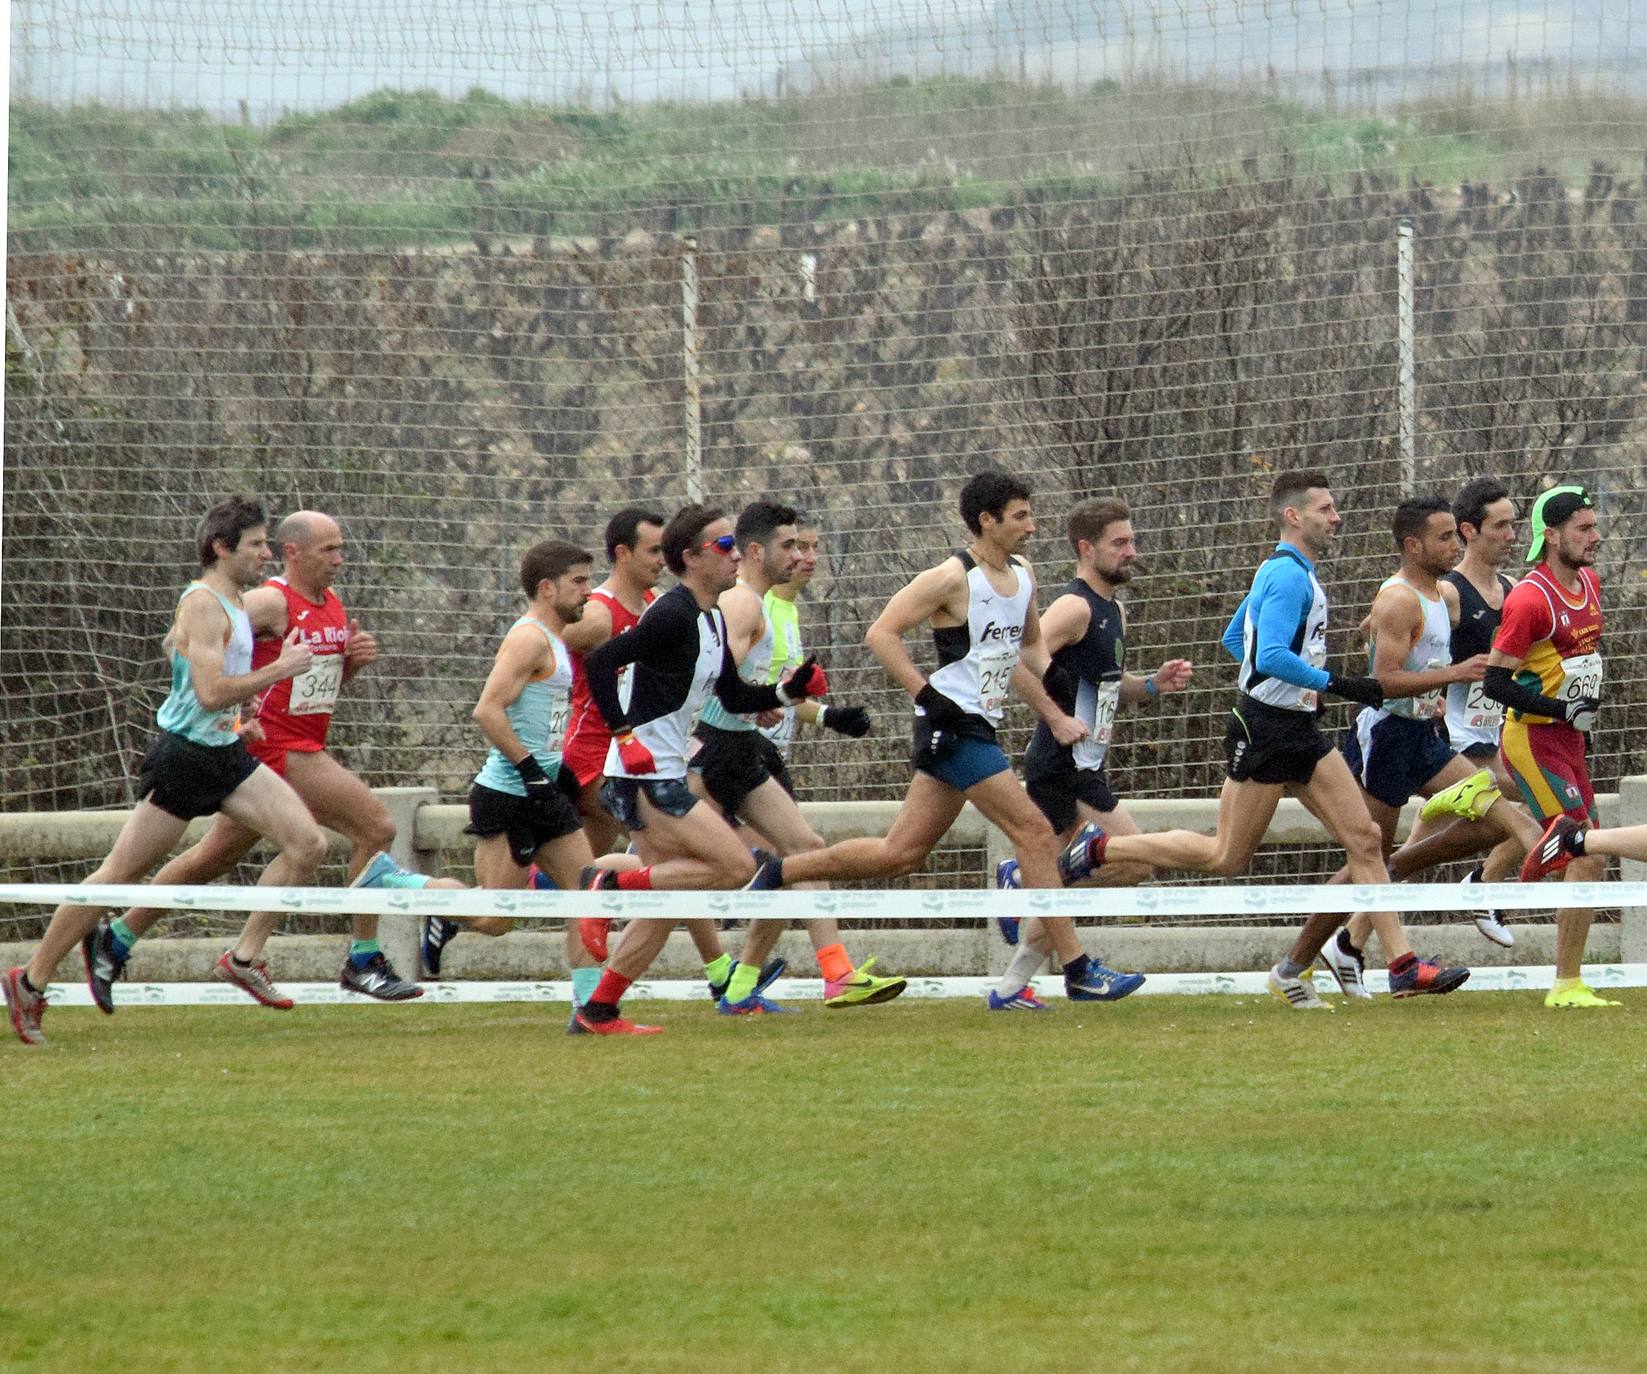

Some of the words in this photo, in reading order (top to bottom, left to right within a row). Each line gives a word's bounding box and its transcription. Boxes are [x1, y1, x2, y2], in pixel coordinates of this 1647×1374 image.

[300, 629, 322, 645] La
[302, 674, 337, 698] 344
[1567, 673, 1597, 699] 669
